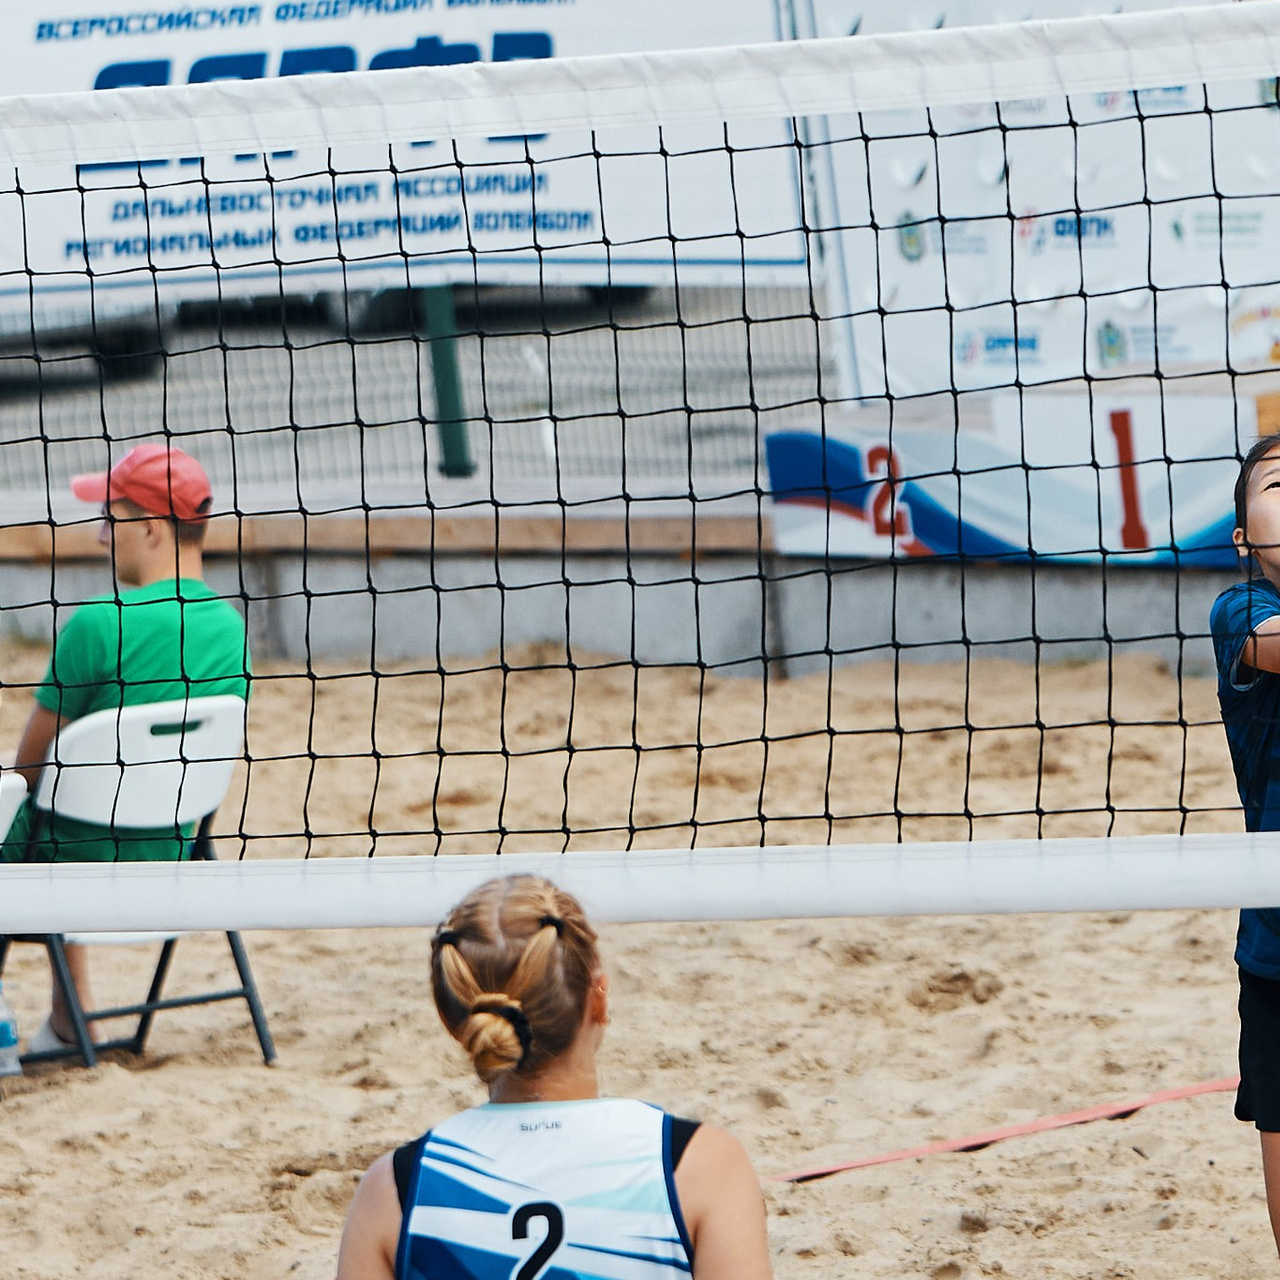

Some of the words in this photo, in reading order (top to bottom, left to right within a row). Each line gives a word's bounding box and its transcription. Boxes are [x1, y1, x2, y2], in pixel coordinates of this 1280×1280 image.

[35, 3, 262, 42] ВСЕРОССИЙСКАЯ
[112, 180, 379, 222] ДАЛЬНЕВОСТОЧНАЯ
[865, 445, 909, 537] 2
